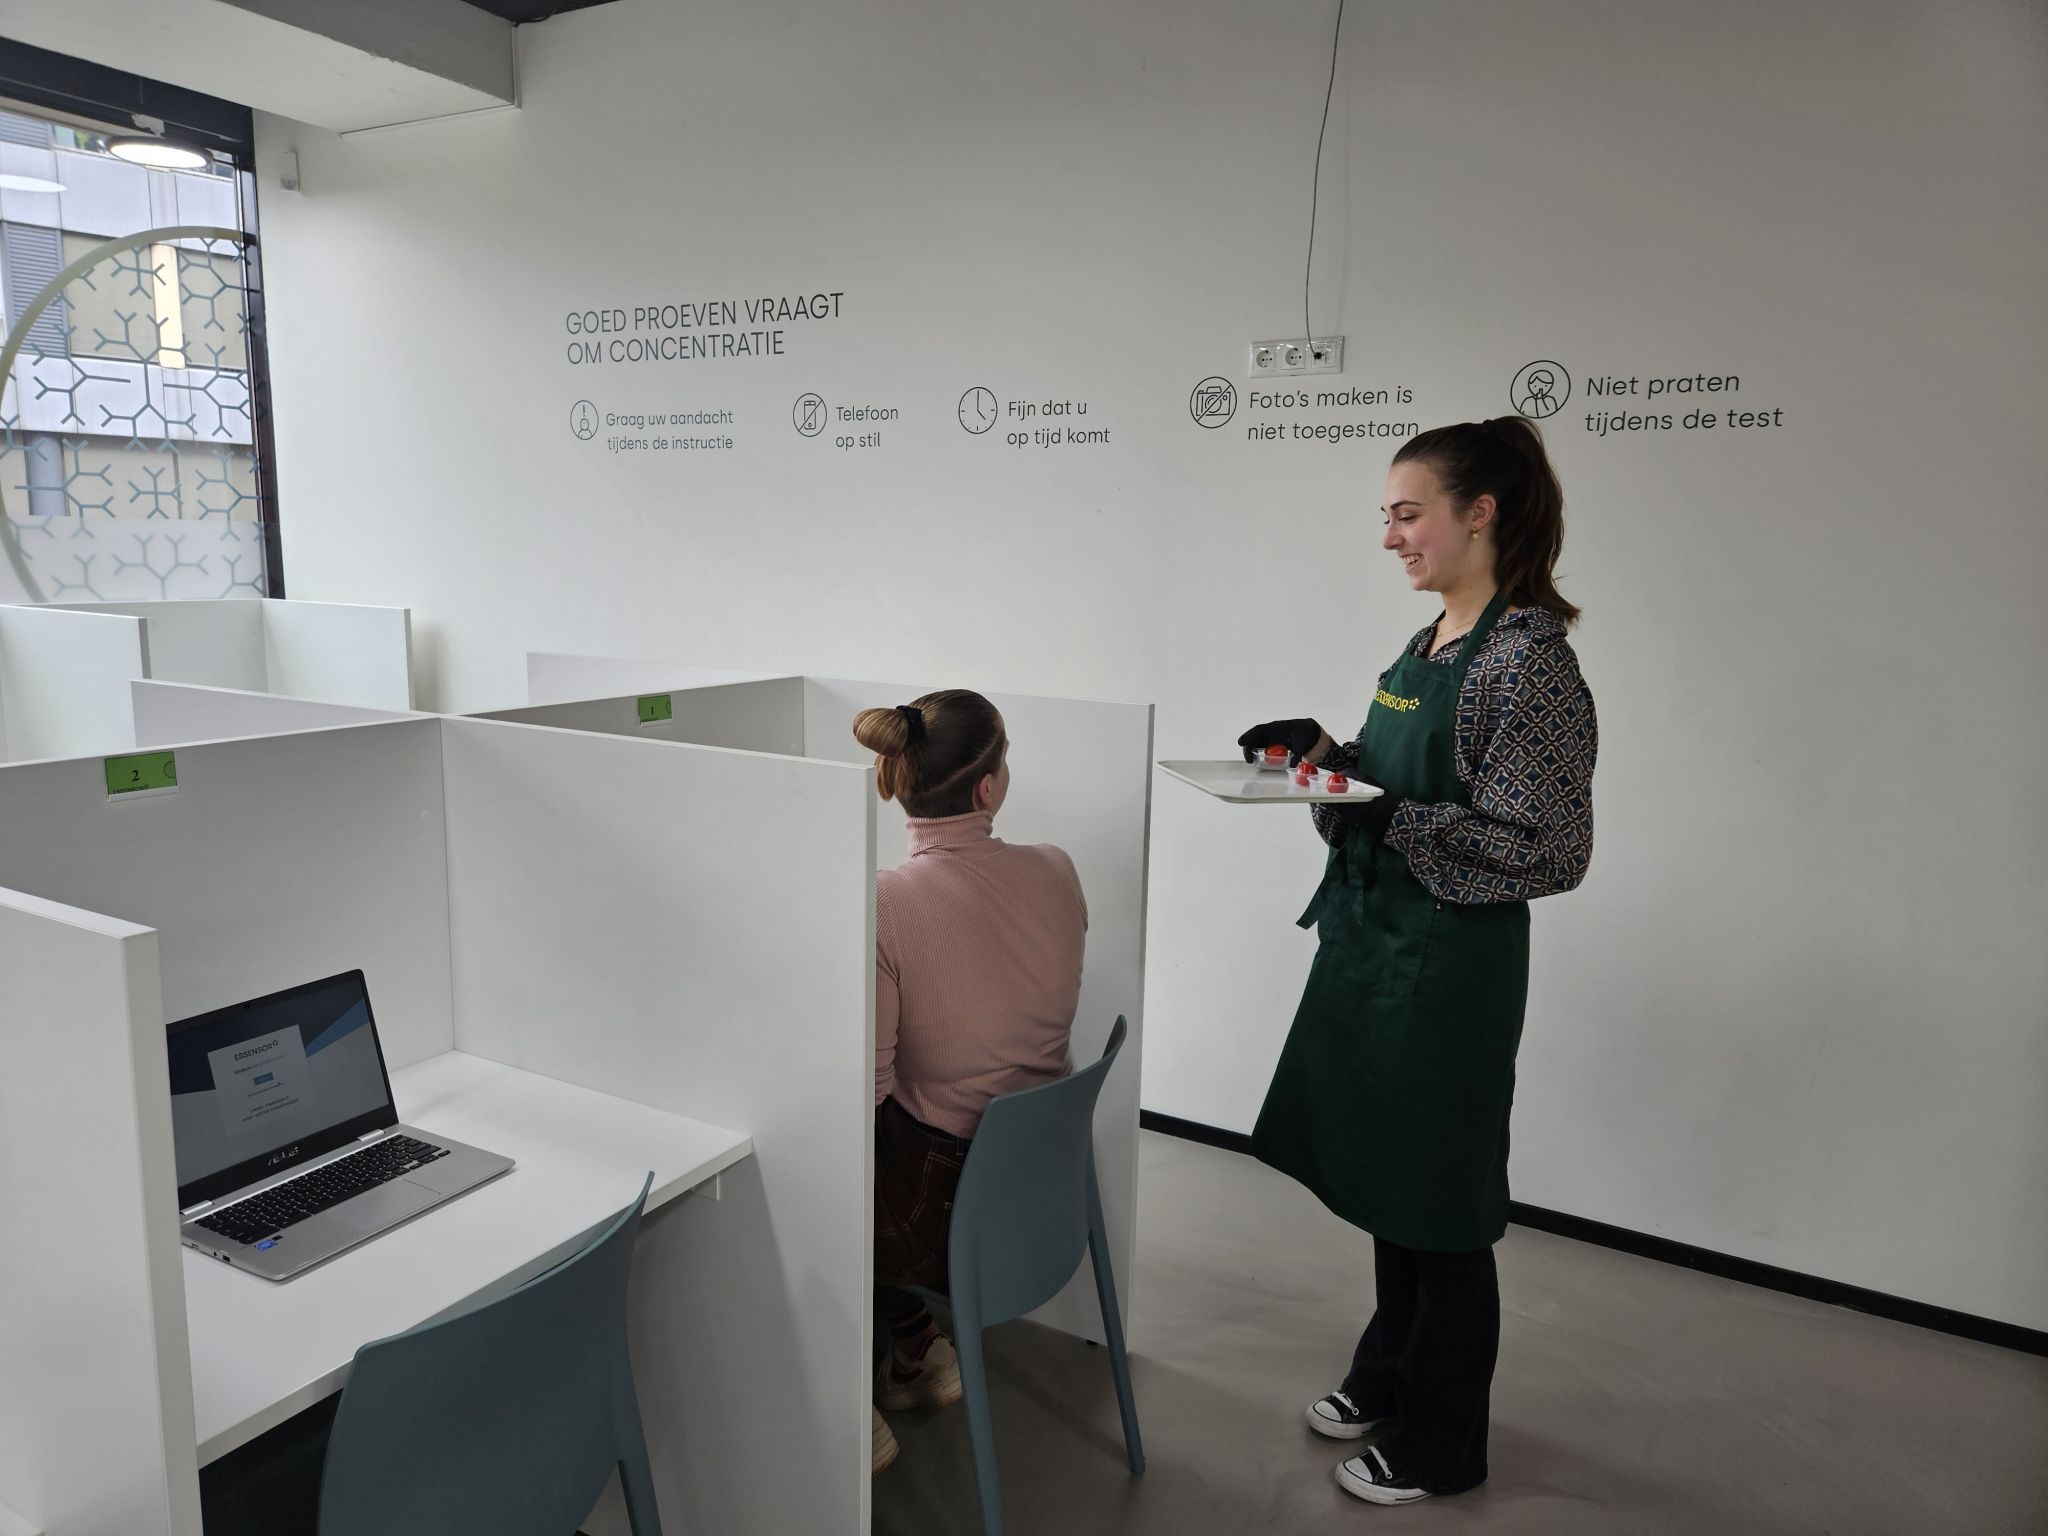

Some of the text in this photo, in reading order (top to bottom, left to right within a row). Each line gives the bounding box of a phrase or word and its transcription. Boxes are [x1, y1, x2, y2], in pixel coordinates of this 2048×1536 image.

[566, 292, 844, 334] GOED PROEVEN VRAAGT
[567, 330, 785, 364] OM CONCENTRATIE
[1249, 386, 1413, 409] Foto's maken is
[1587, 373, 1740, 400] Niet praten
[605, 410, 734, 429] Graag uw aandacht
[835, 405, 899, 421] Telefoon
[1008, 399, 1088, 421] Fijn dat u
[1248, 420, 1419, 444] niet toegestaan
[1585, 407, 1784, 437] tijdens de test
[607, 435, 733, 454] tijdens de instructie
[835, 432, 881, 451] op stil
[1006, 427, 1111, 449] op tijd komt
[131, 769, 141, 782] 2
